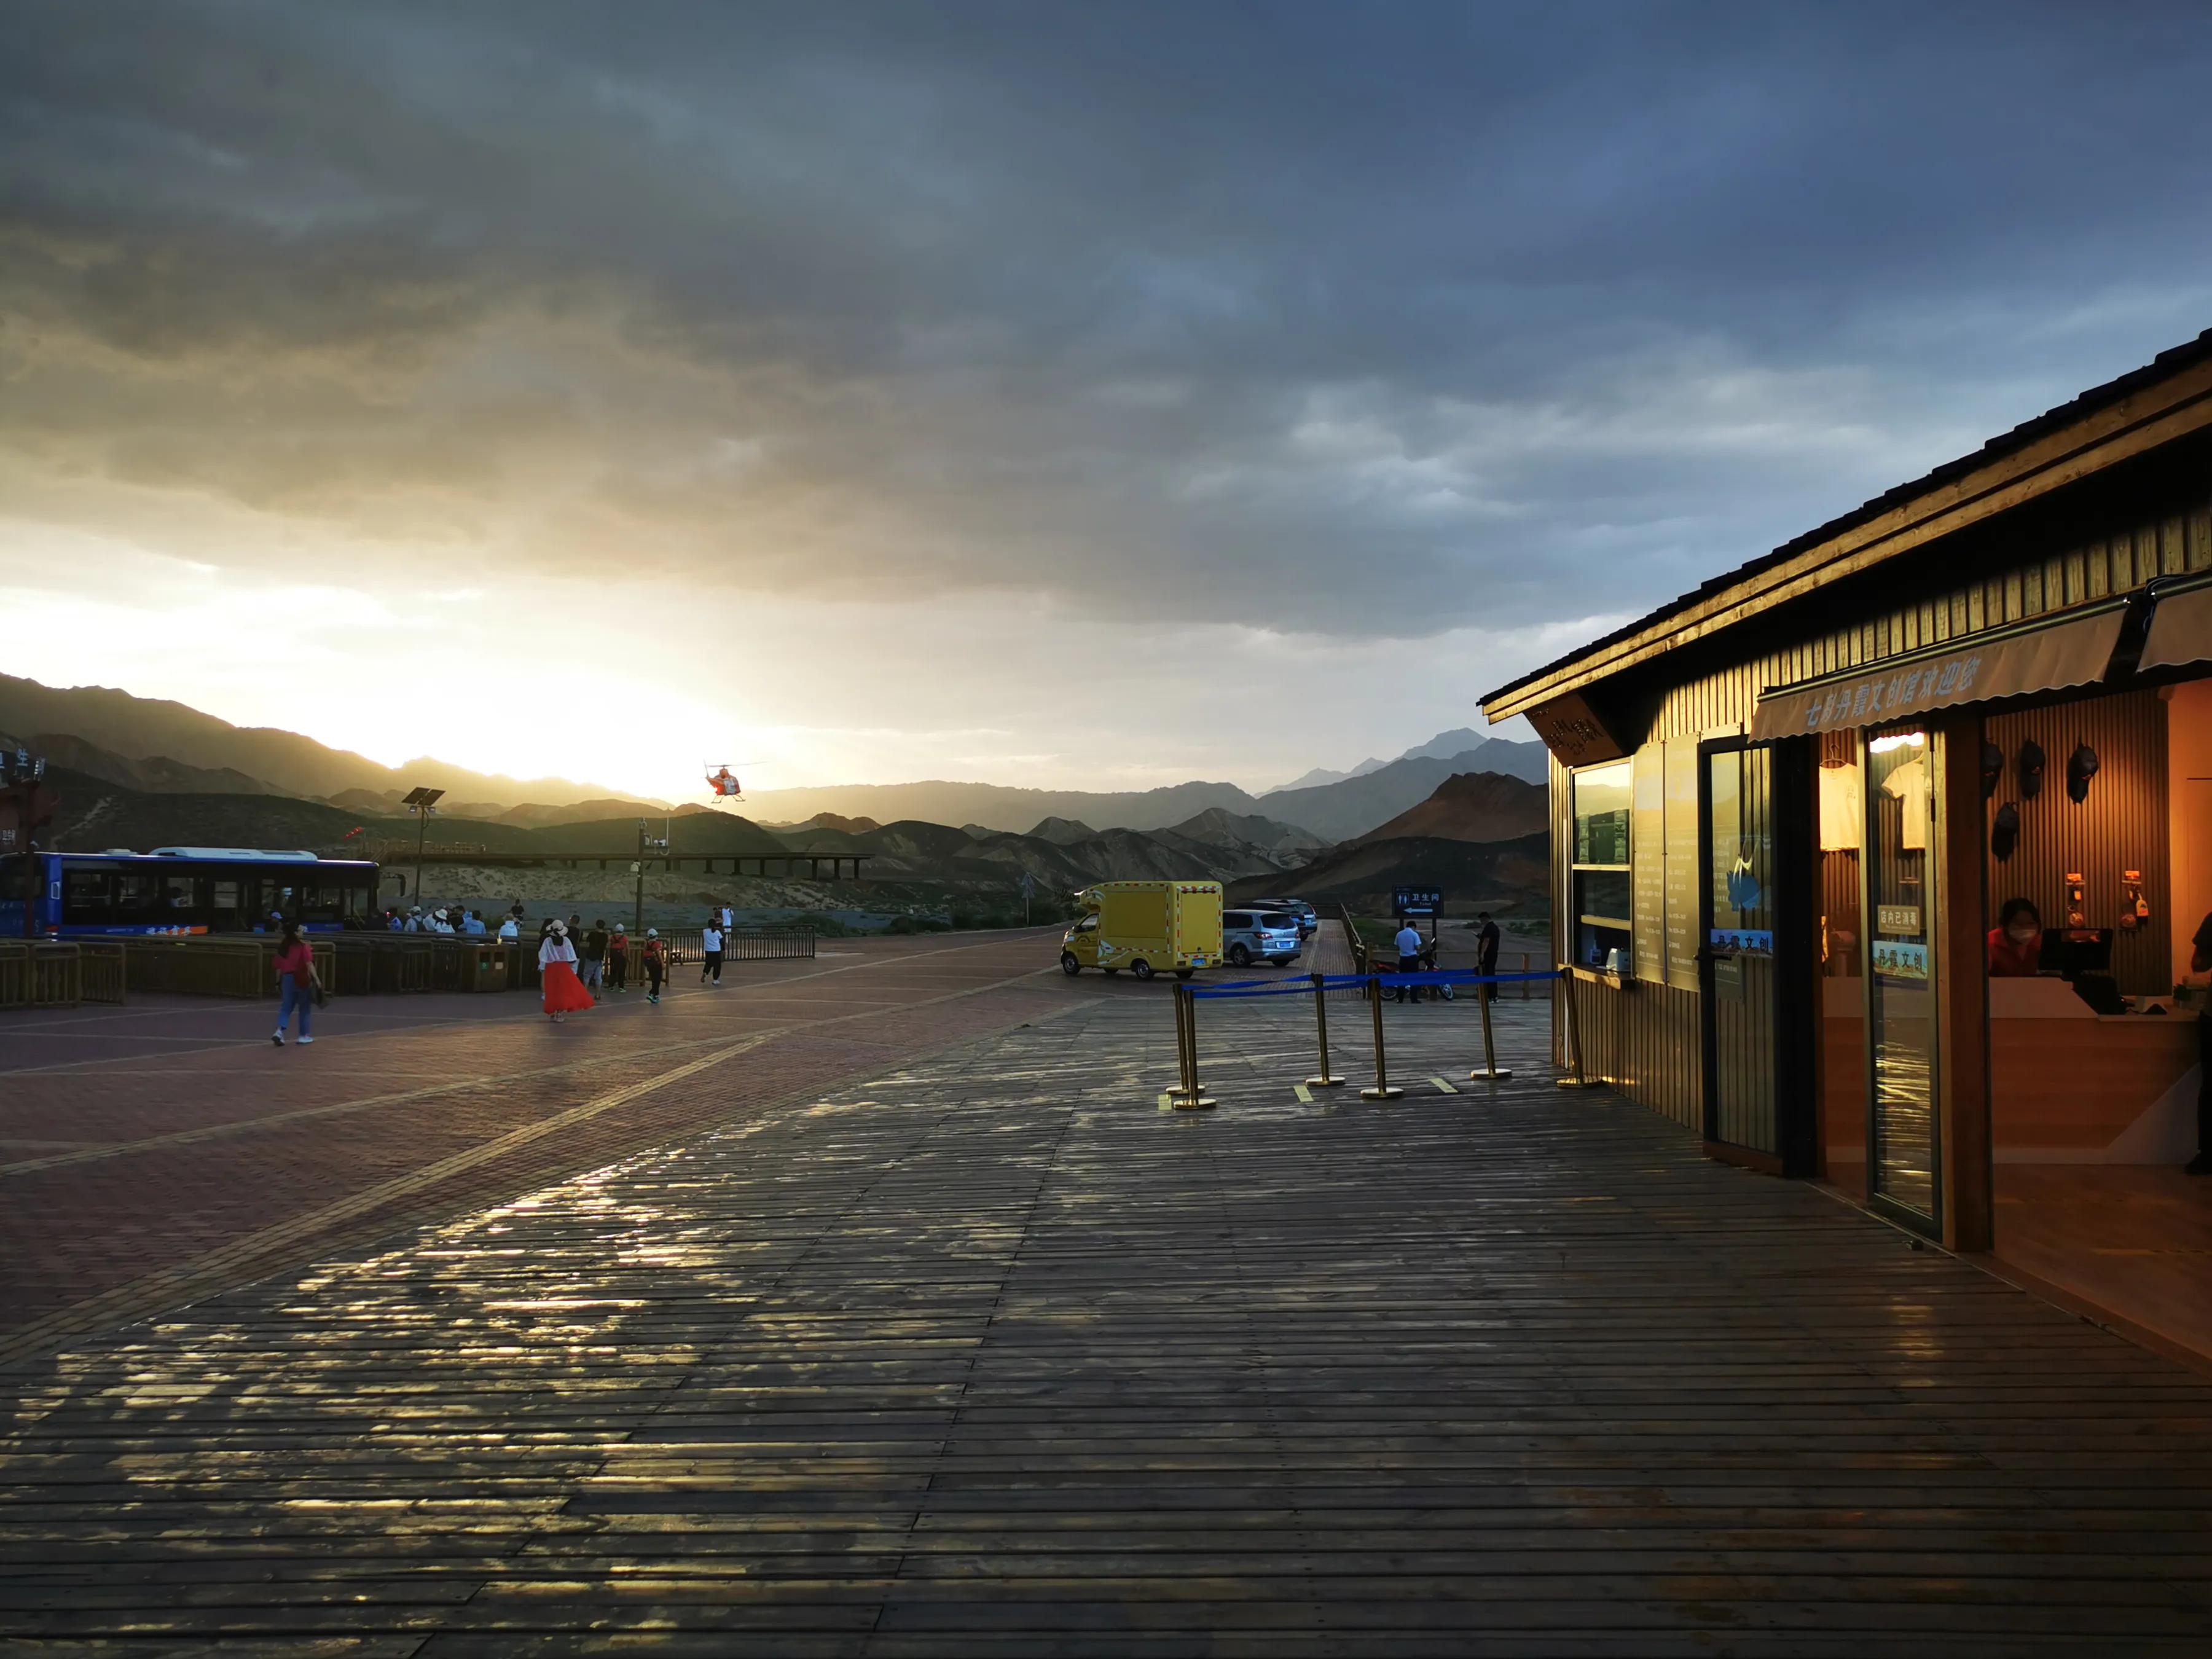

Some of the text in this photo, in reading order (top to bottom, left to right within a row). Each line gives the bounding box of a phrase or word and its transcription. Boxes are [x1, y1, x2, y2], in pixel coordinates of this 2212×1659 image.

[1805, 656, 1982, 726] 七彩丹霞文创馆欢迎您
[1411, 893, 1439, 901] 卫生间
[1878, 949, 1923, 970] 丹霞文创
